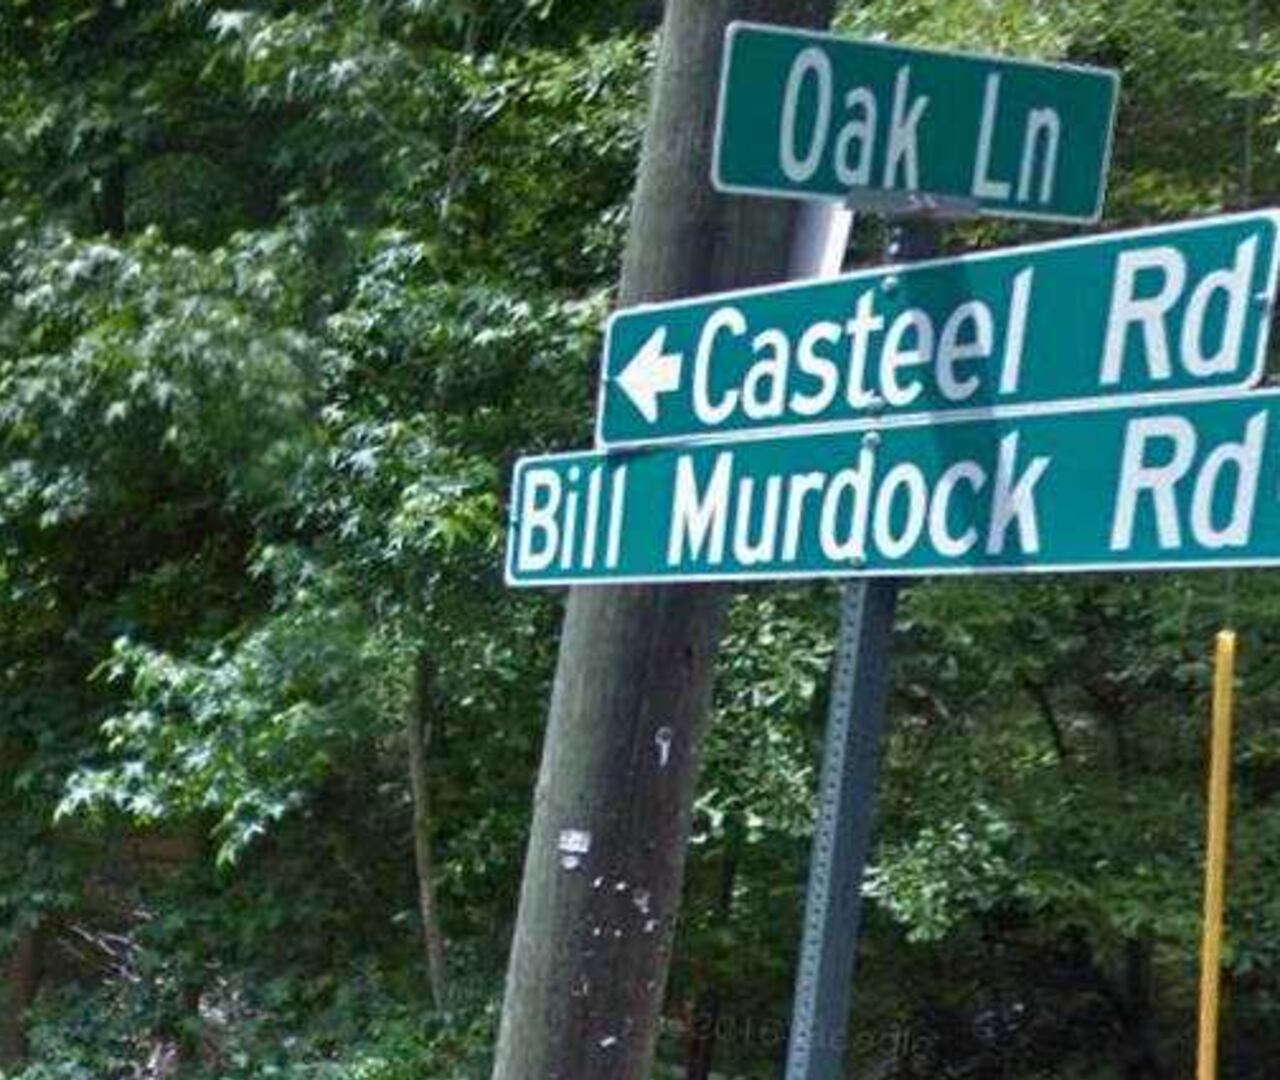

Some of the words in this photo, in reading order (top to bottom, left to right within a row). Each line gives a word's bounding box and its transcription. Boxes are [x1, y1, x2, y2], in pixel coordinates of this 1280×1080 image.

[778, 46, 930, 190] Oak
[970, 72, 1062, 203] Ln
[692, 266, 1035, 425] Casteel
[1098, 232, 1259, 386] Rd
[517, 464, 628, 572] Bill
[666, 429, 1052, 567] Murdock
[1108, 408, 1268, 553] Rd
